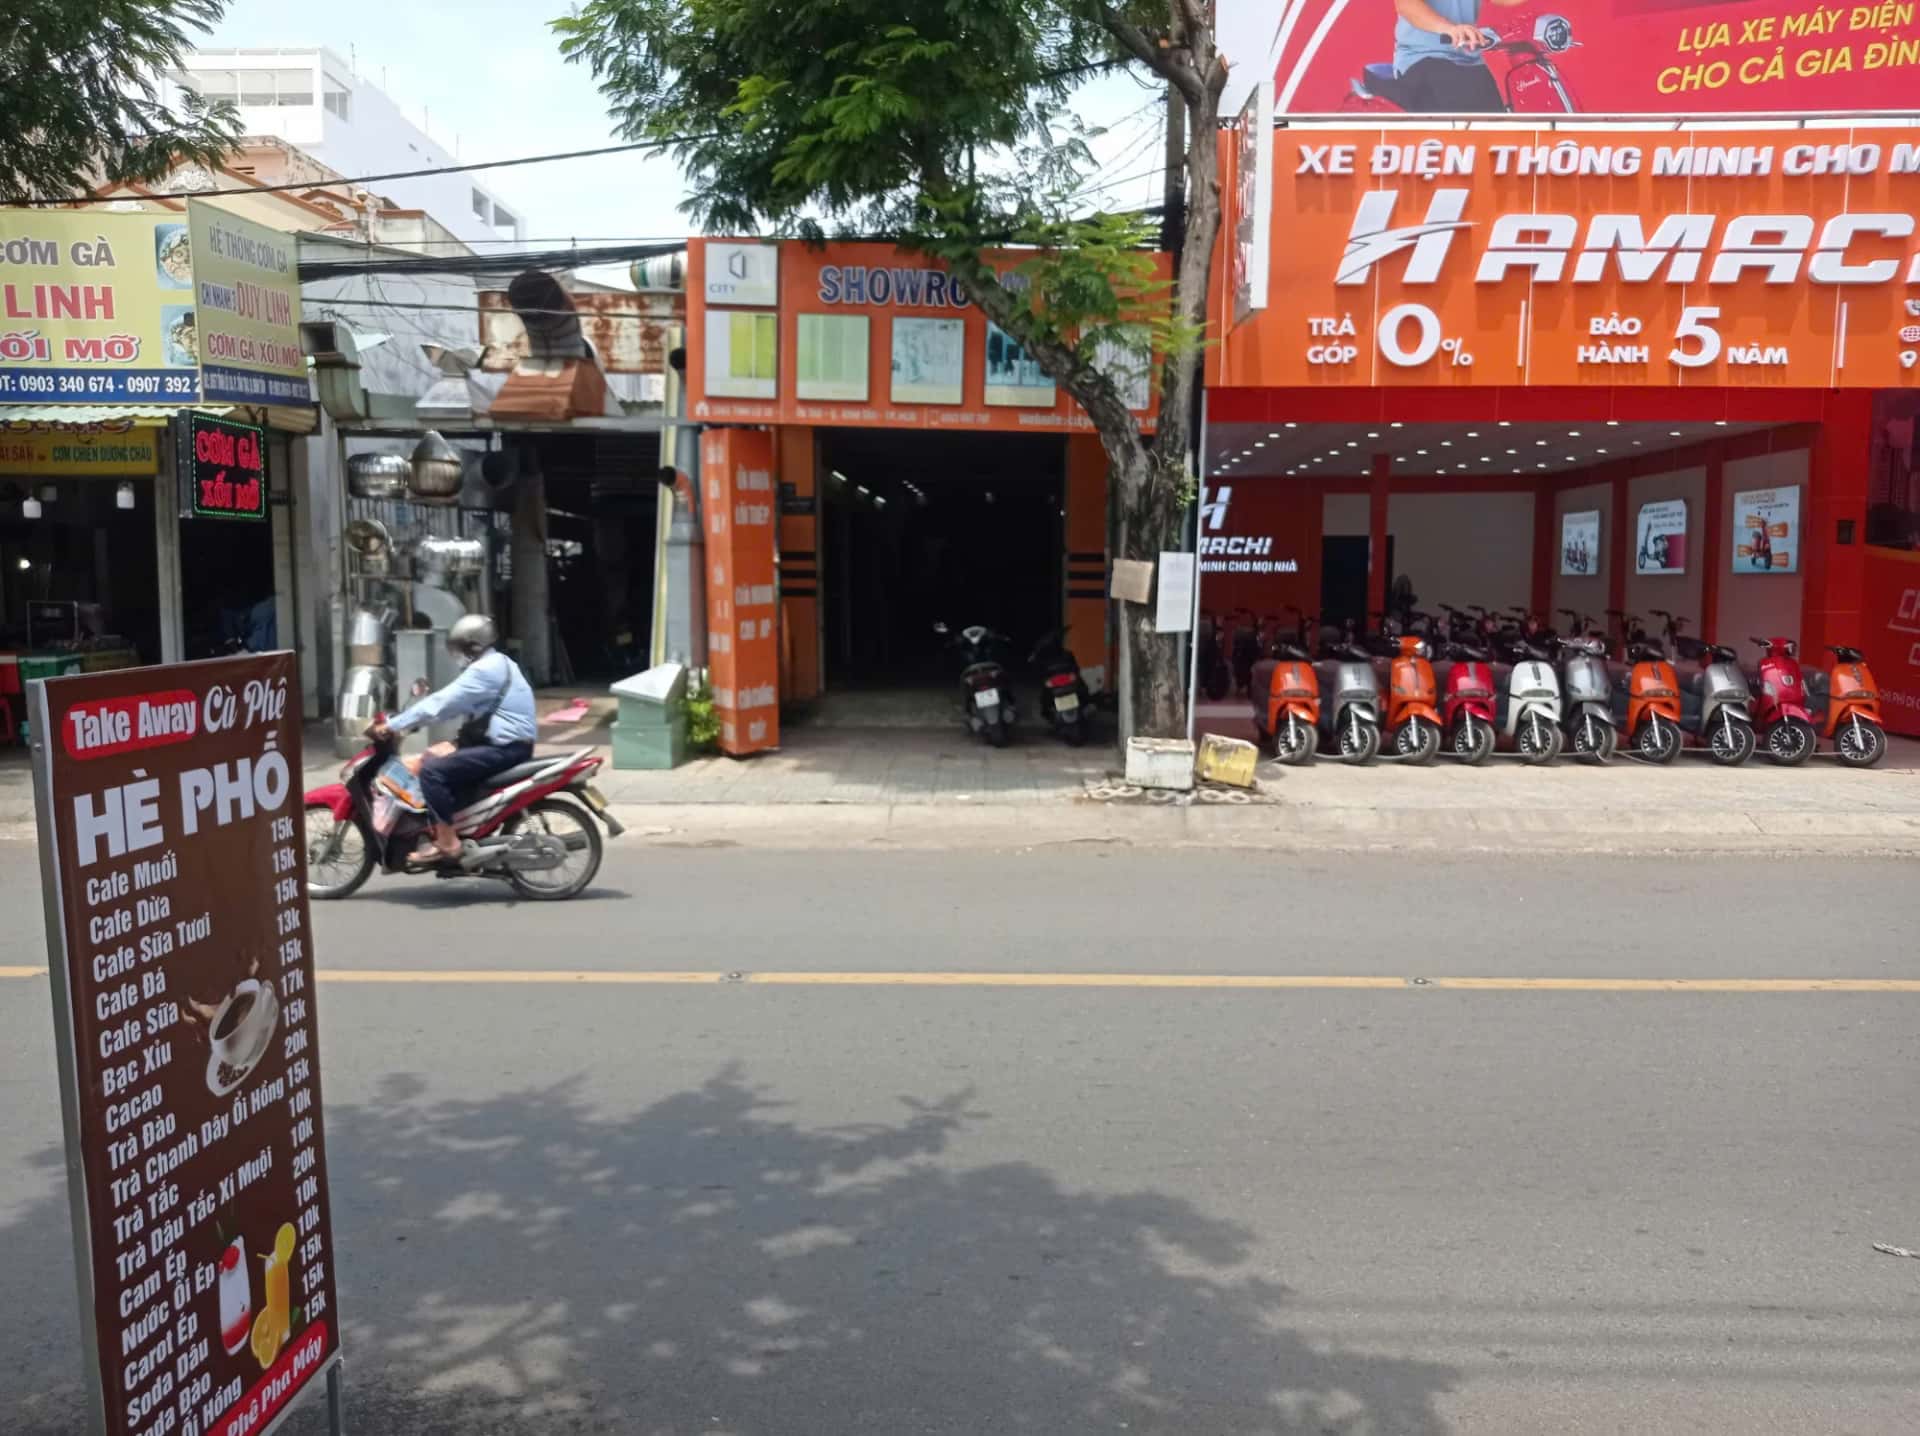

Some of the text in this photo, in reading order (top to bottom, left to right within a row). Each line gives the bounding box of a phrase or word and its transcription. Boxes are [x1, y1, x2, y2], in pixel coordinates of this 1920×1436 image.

[1657, 35, 1920, 94] CHO CẢ GIA ĐÌN
[1678, 0, 1914, 57] LỰA XE MÁY ĐIỆN
[1296, 145, 1357, 175] XE
[1369, 138, 1476, 181] ĐIỆN
[1487, 140, 1642, 177] THÔNG
[1651, 146, 1775, 177] MINH
[1782, 143, 1881, 176] CHO
[70, 234, 116, 267] GÀ
[4, 283, 116, 320] LINH
[237, 281, 260, 321] DUY
[264, 287, 292, 327] LINH
[1307, 313, 1357, 337] TRẢ
[1589, 311, 1642, 336] BẢO
[1668, 306, 1789, 368] 5 NĂM
[0, 329, 142, 363] ỐI MỠ
[207, 332, 236, 357] CƠM
[240, 336, 256, 361] GÀ
[1306, 339, 1359, 365] GÓP
[1576, 340, 1650, 364] HÀNH
[0, 376, 16, 392] T:
[19, 376, 55, 392] 0903
[59, 376, 85, 392] 340
[88, 376, 114, 393] 674
[127, 377, 160, 393] 0907
[165, 377, 191, 393] 392
[196, 427, 262, 472] CƠM GÀ
[1228, 560, 1251, 572] CHO
[1252, 560, 1273, 574] MỌI
[1274, 558, 1299, 572] NHÀ
[70, 676, 288, 750] Take Away Cà Phê
[73, 730, 290, 868] HÈ PHỐ
[86, 816, 294, 906] Cafe Muối 15k
[90, 847, 296, 944] Cafe Dừa 15k
[93, 877, 298, 982] Cafe Sữa Tươi 15k
[96, 907, 300, 1020] Cafe Đá 13k
[100, 938, 302, 1058] Cafe Sữa 15k
[103, 1060, 138, 1097] Bạc
[280, 968, 304, 997] 17k
[105, 998, 305, 1133] Cacao 15k
[107, 1029, 308, 1171] Trà Đào 20k
[110, 1168, 141, 1208] Trà
[145, 1132, 198, 1184] Chanh
[201, 1112, 229, 1148] Dây
[287, 1057, 309, 1088] 15k
[113, 1087, 312, 1245] Trà Tắc 10k
[116, 1117, 314, 1281] Trà Dâu Tắc Xí Muội 10k
[120, 1146, 315, 1318] Cam Ép 20k
[122, 1300, 169, 1356] Nước
[195, 1261, 215, 1294] Ép
[296, 1176, 318, 1207] 10k
[124, 1204, 320, 1391] Carot Ép 10k
[127, 1232, 322, 1427] Soda Dâu 15k
[304, 1290, 326, 1323] 15k
[136, 1260, 324, 1436] da Đào 15k
[262, 1369, 291, 1412] Pha
[293, 1335, 322, 1378] Máy
